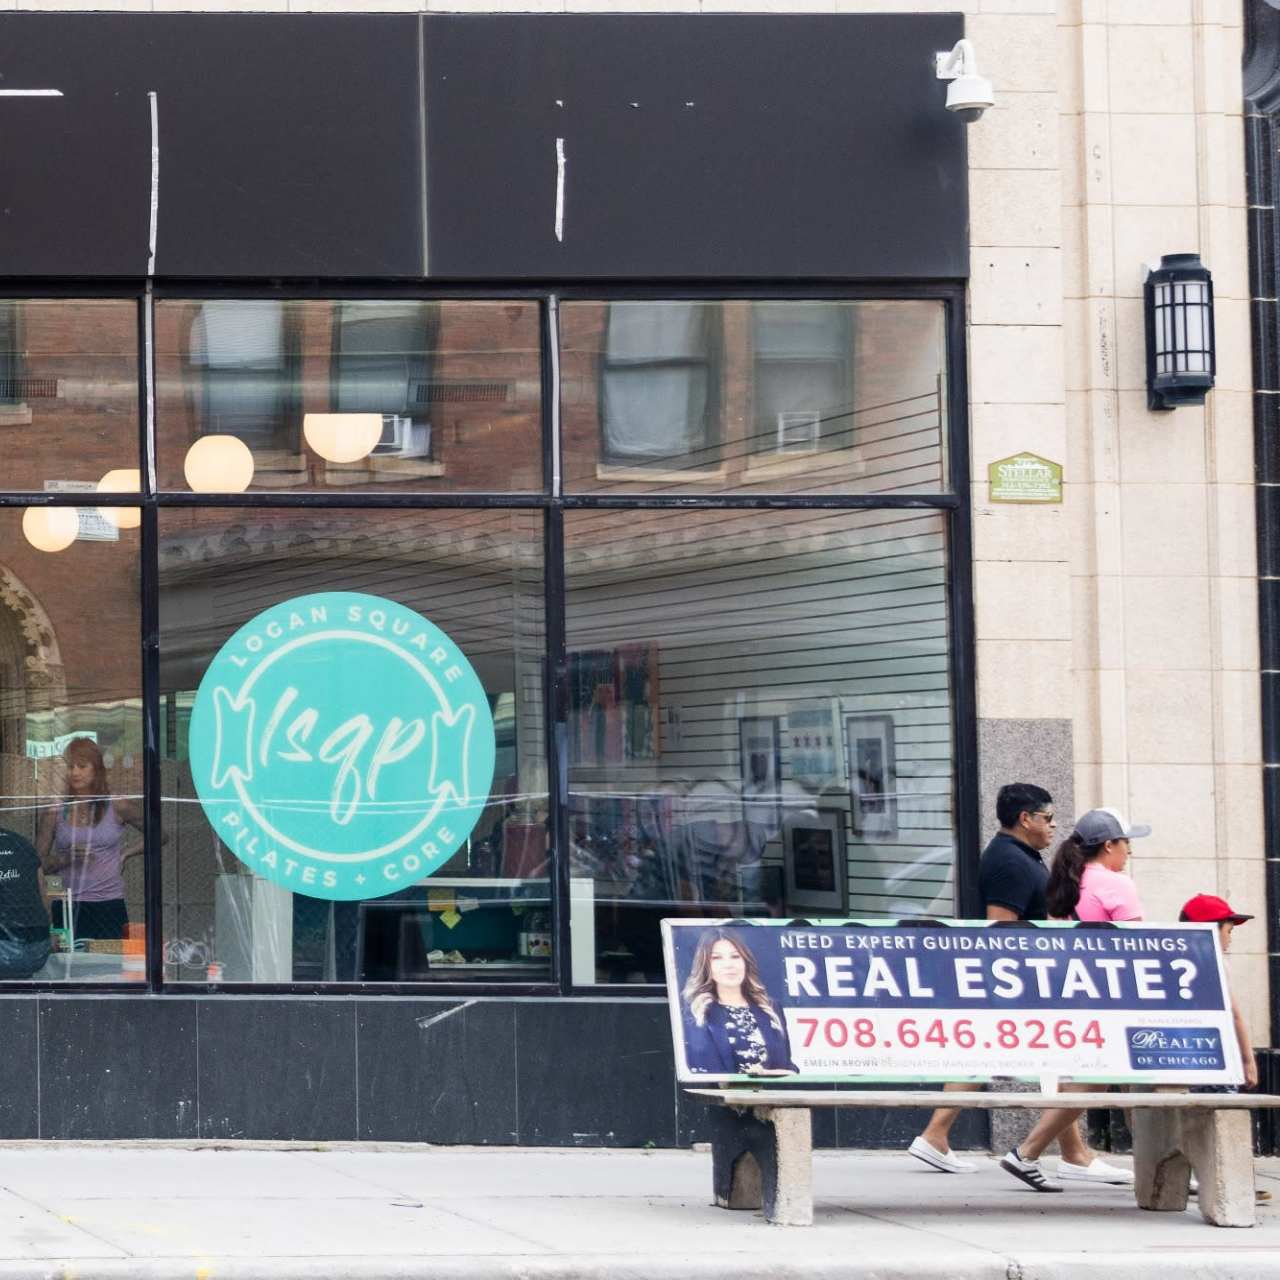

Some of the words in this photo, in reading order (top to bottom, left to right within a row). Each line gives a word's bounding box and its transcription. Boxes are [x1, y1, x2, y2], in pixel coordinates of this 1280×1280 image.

[229, 605, 329, 669] LOGAN
[347, 605, 462, 682] SQUARE
[221, 810, 337, 888] PILATES
[382, 824, 455, 881] CORE
[780, 935, 833, 949] NEED
[845, 935, 916, 949] EXPERT
[923, 936, 1033, 951] GUIDANCE
[1035, 936, 1068, 951] ON
[1073, 937, 1106, 951] ALL
[1111, 937, 1188, 952] THINGS
[784, 956, 935, 998] REAL
[954, 956, 1198, 1000] ESTATE?
[796, 1017, 1106, 1050] 708.646.8264
[842, 1058, 879, 1068] BROWN
[1137, 1056, 1153, 1065] OF
[1158, 1056, 1217, 1066] CHICAGO
